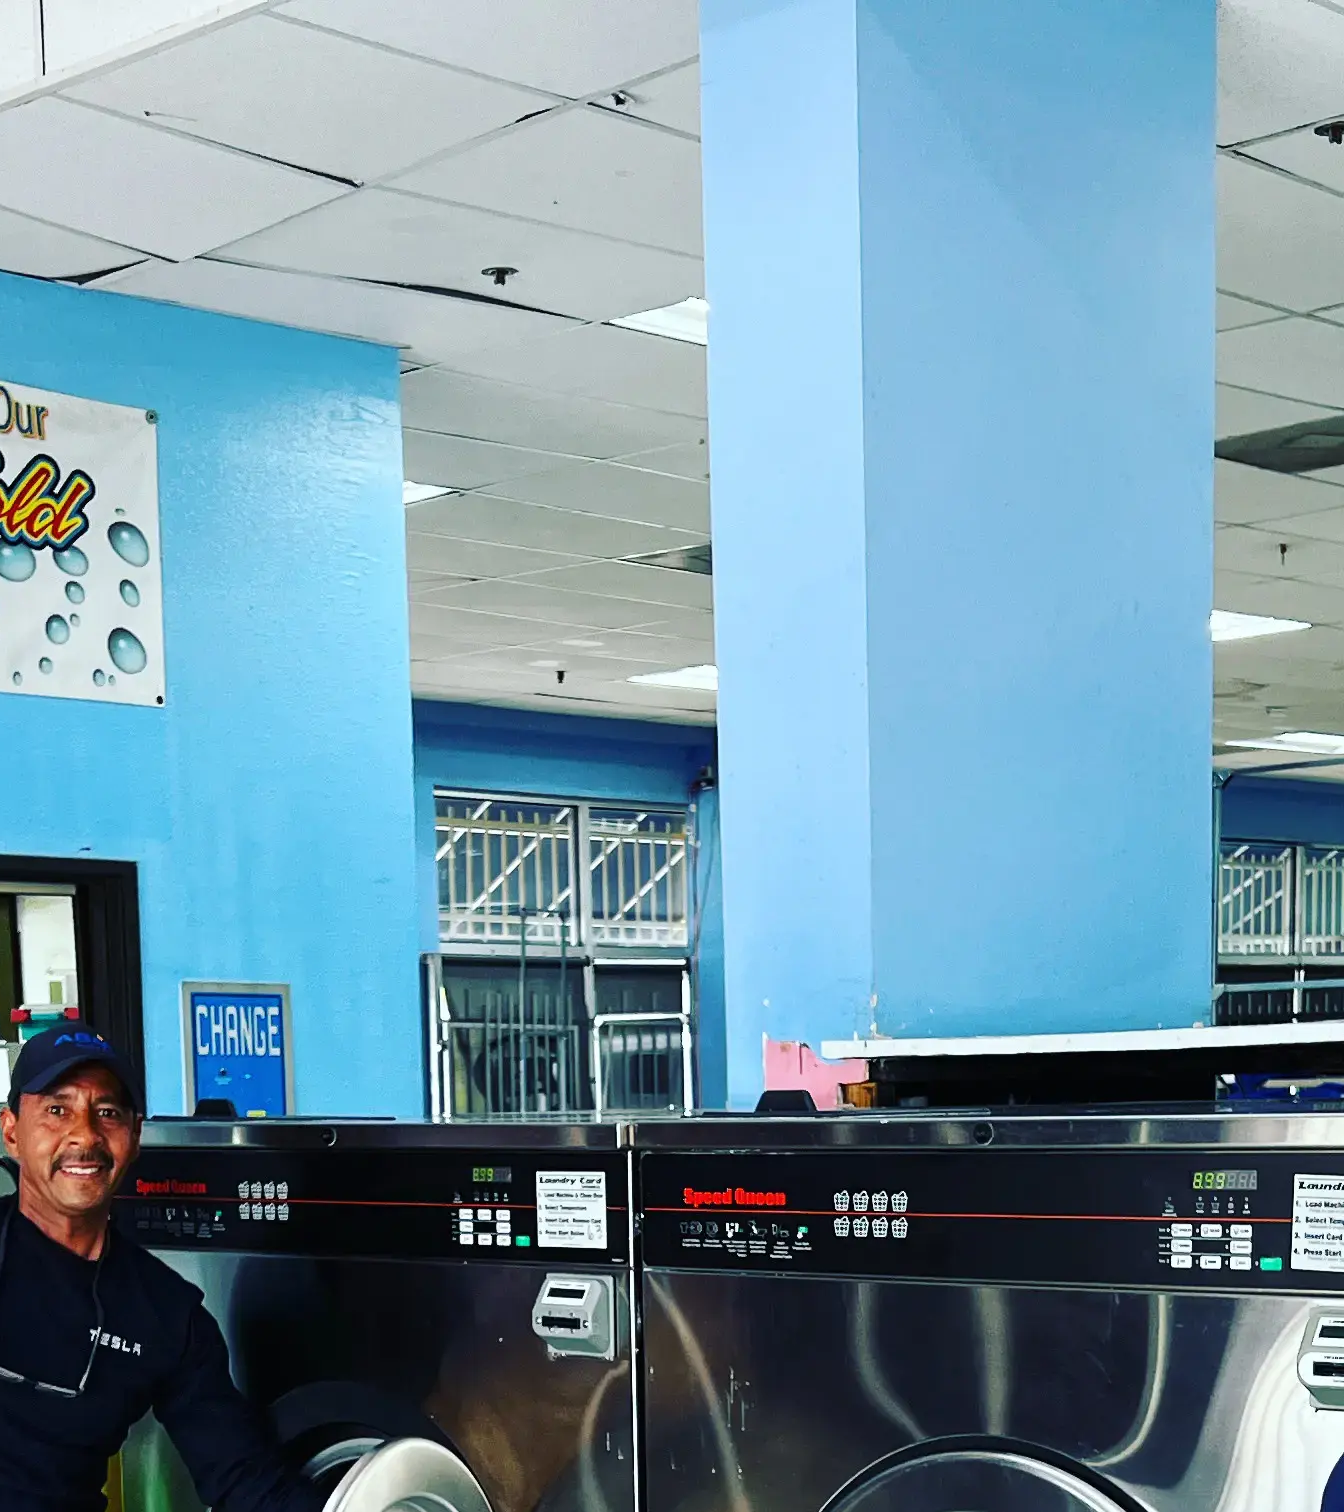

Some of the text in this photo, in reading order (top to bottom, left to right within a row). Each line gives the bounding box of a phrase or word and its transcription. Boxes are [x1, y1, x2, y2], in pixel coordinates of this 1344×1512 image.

[195, 1004, 281, 1057] CHANGE
[683, 1187, 786, 1208] Speed Queen
[89, 1327, 142, 1357] TESLA
